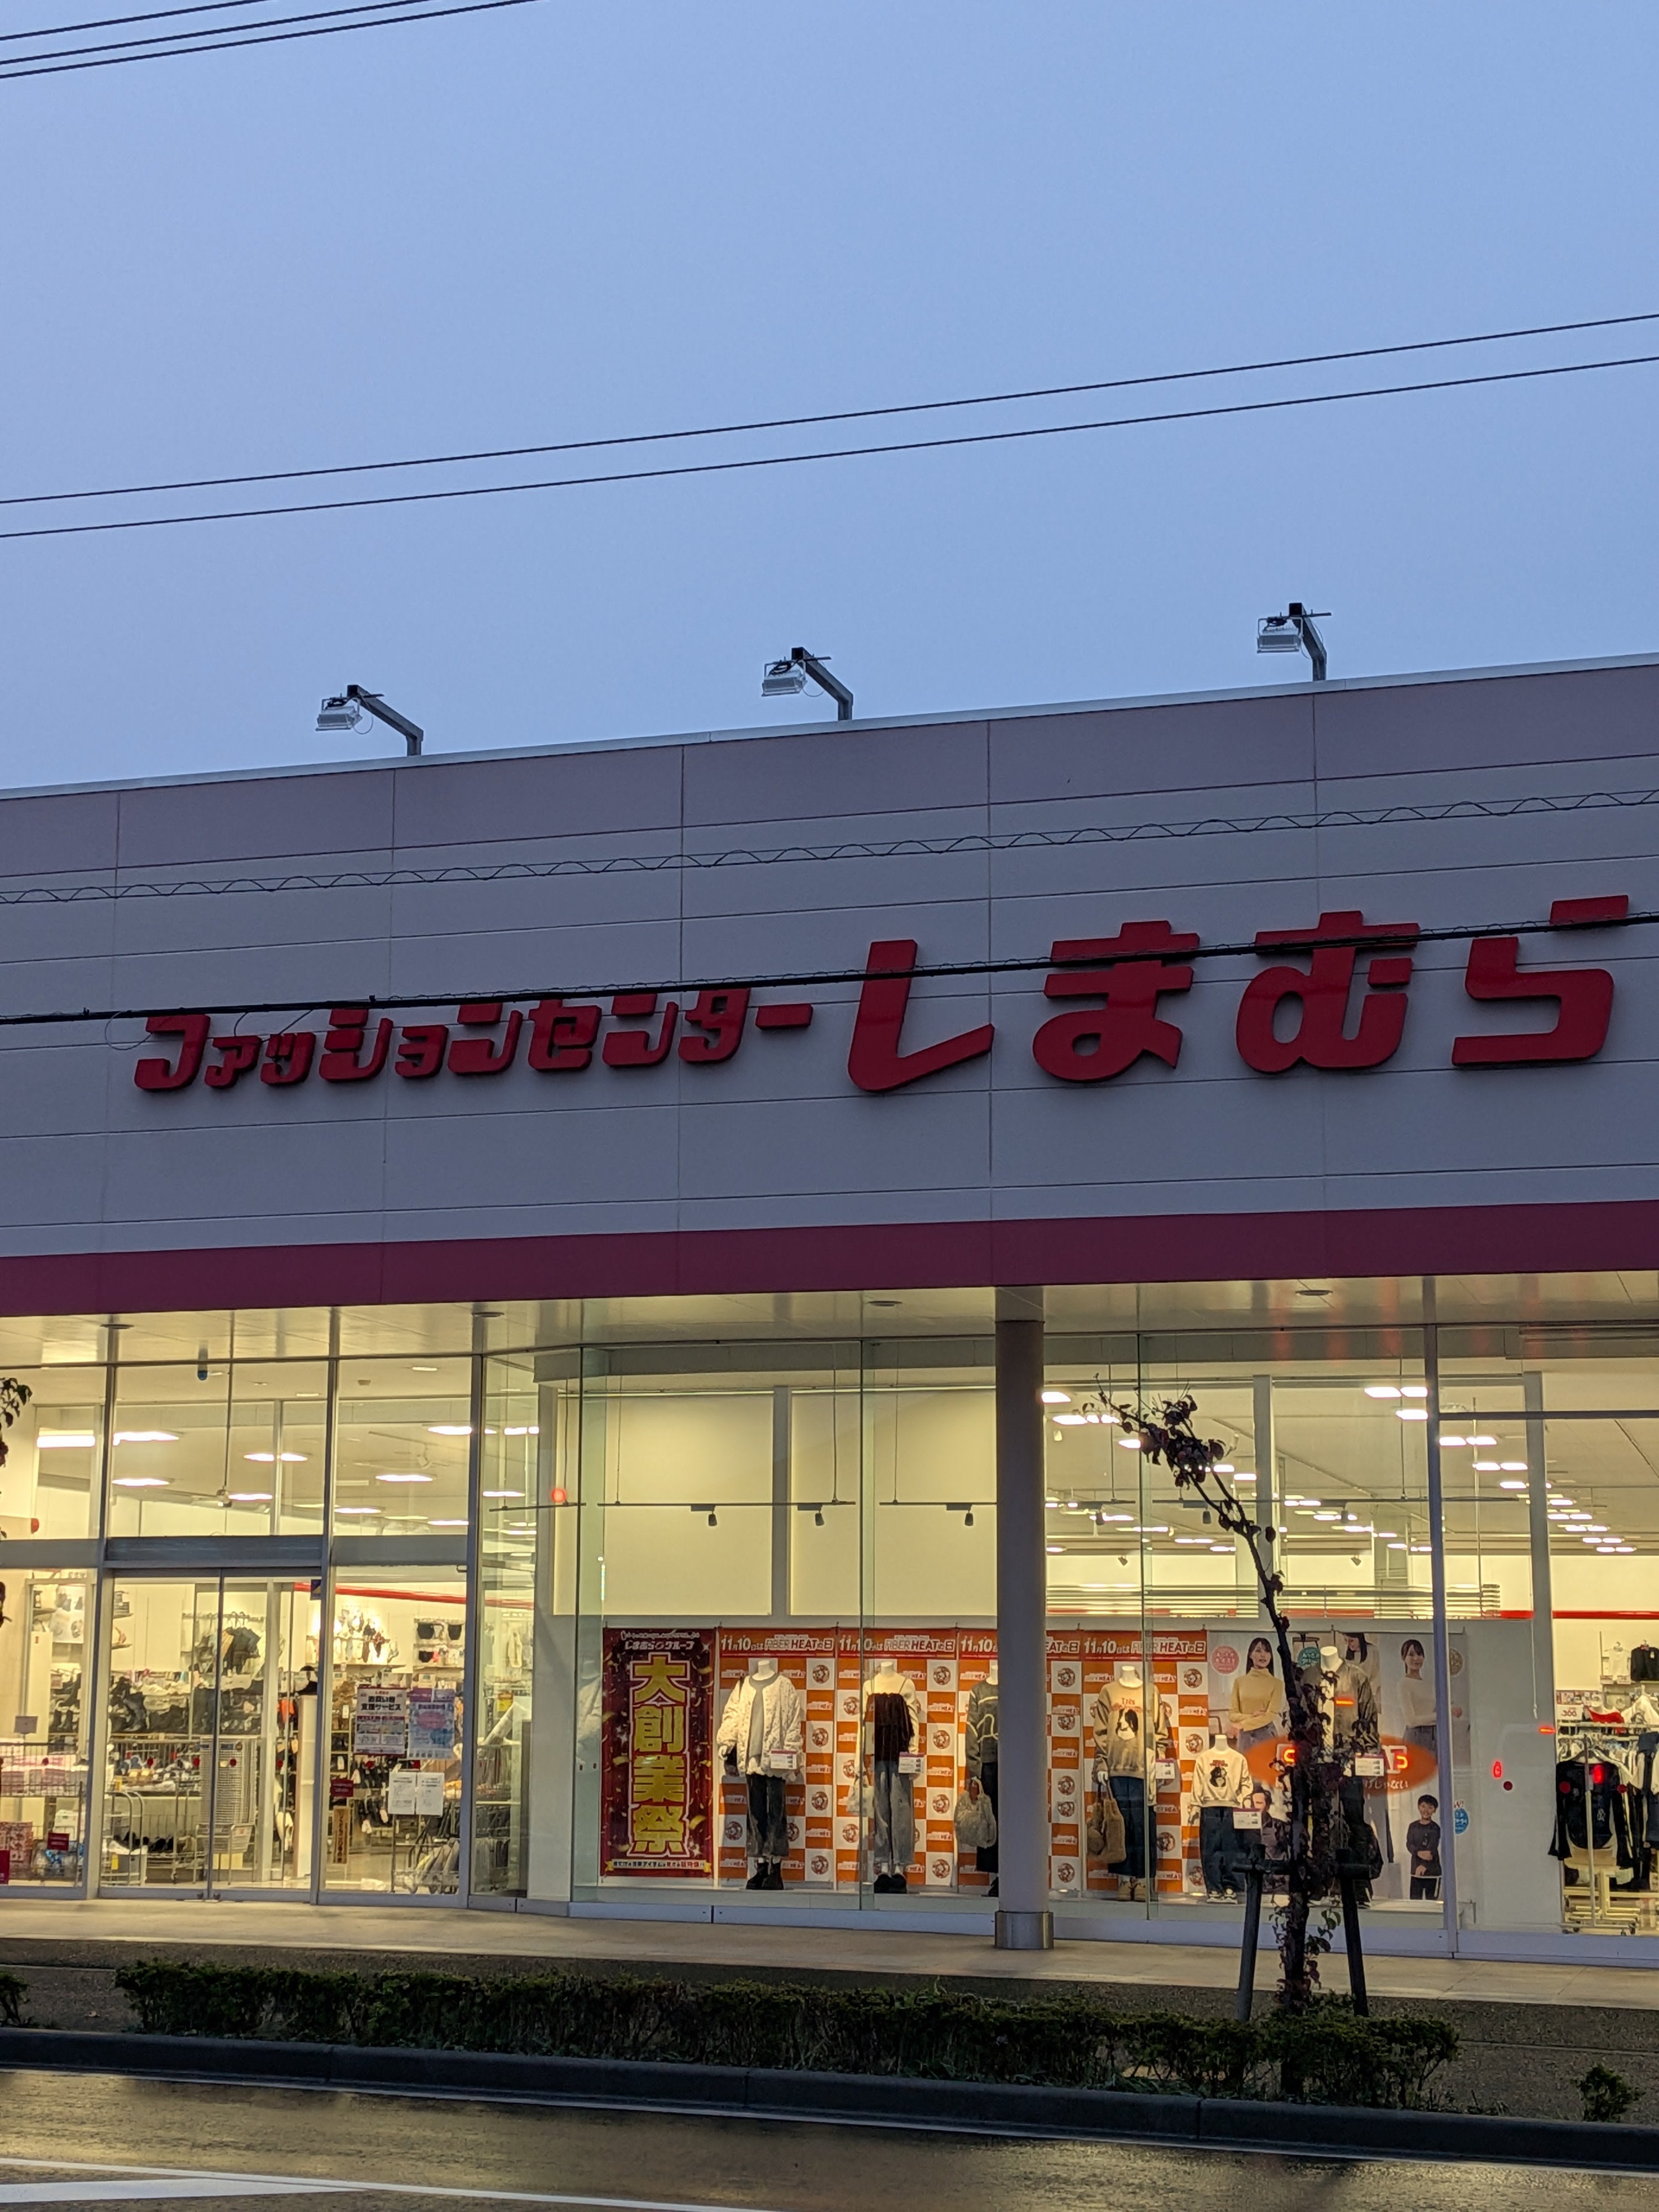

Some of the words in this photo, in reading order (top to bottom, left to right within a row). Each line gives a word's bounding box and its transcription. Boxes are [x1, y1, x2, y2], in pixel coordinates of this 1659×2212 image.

[134, 987, 813, 1091] ファッションセンター
[847, 894, 1629, 1093] しまむら
[633, 1655, 687, 1854] 大創業祭
